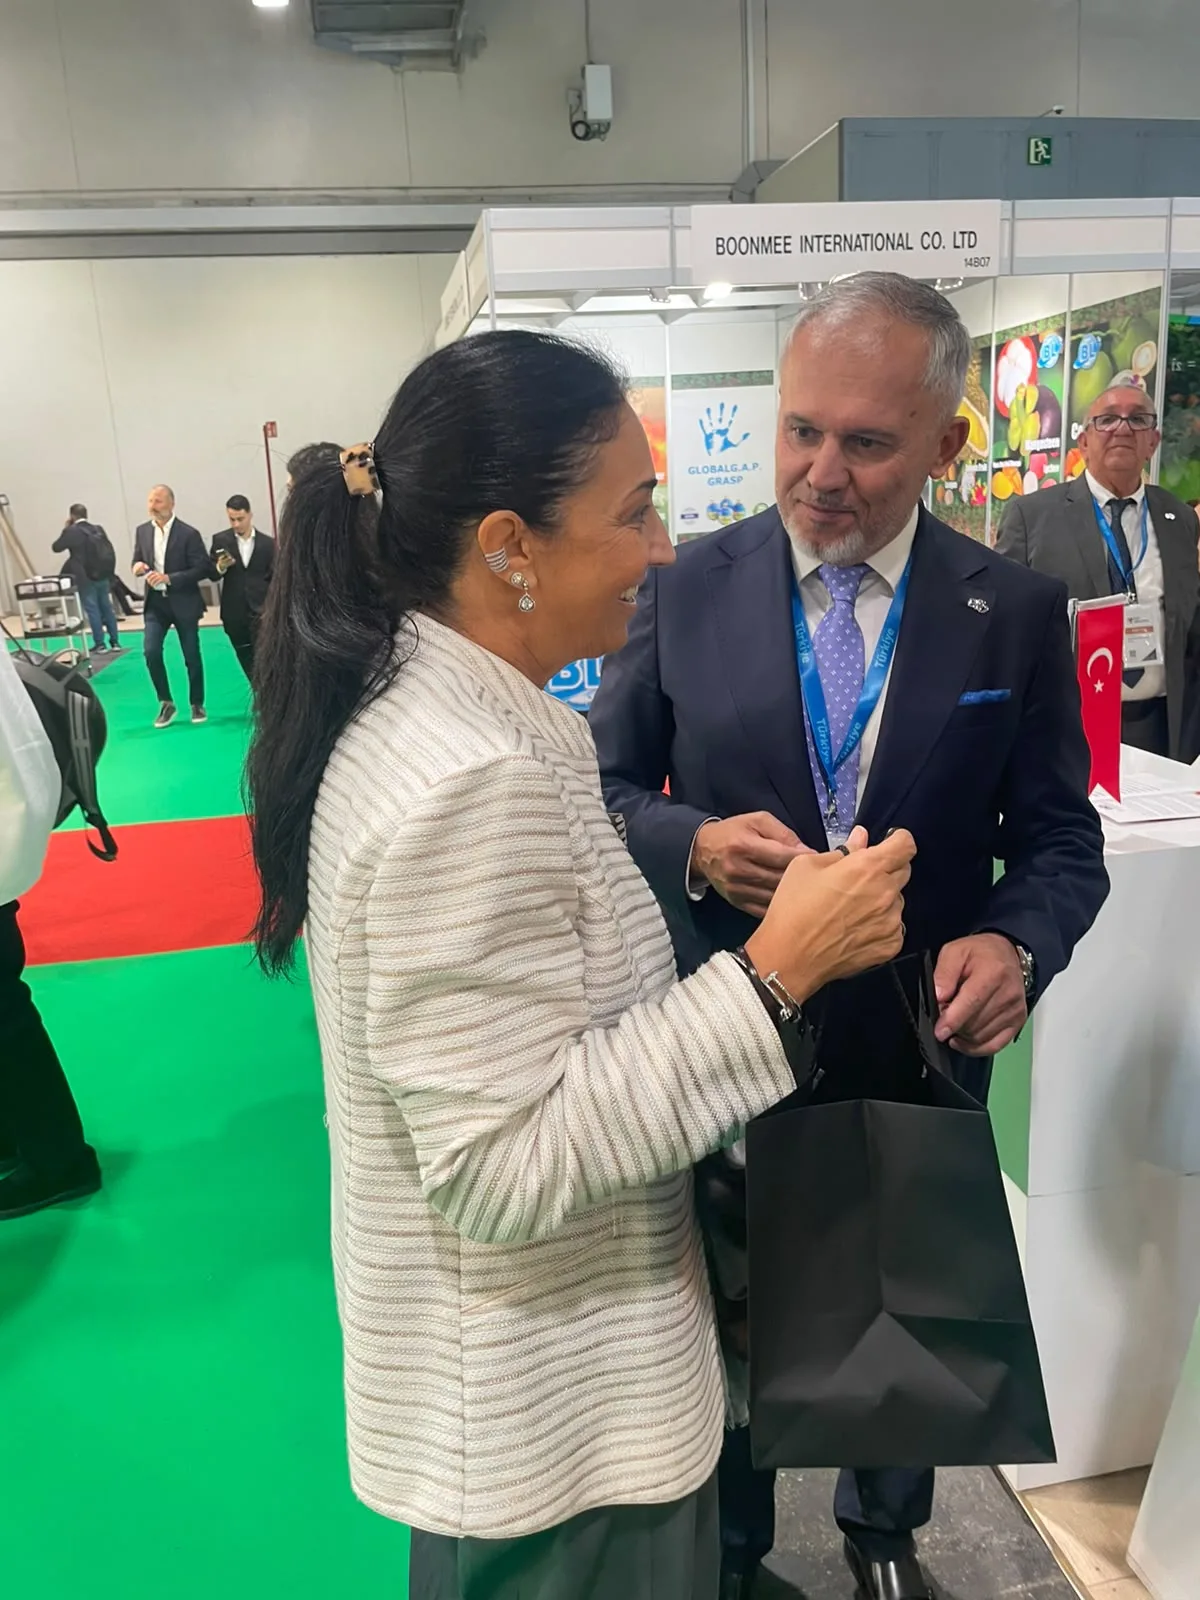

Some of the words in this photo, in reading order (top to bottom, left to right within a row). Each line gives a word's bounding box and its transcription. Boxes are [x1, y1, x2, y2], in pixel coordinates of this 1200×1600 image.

[715, 235, 793, 256] BOONMEE
[799, 232, 914, 254] INTERNATIONAL
[920, 230, 946, 251] CO.
[953, 230, 978, 249] LTD
[964, 256, 991, 268] 14B07
[687, 462, 762, 476] GLOBALG.A.P.
[707, 475, 744, 487] GRASP
[873, 627, 895, 668] Türkiye
